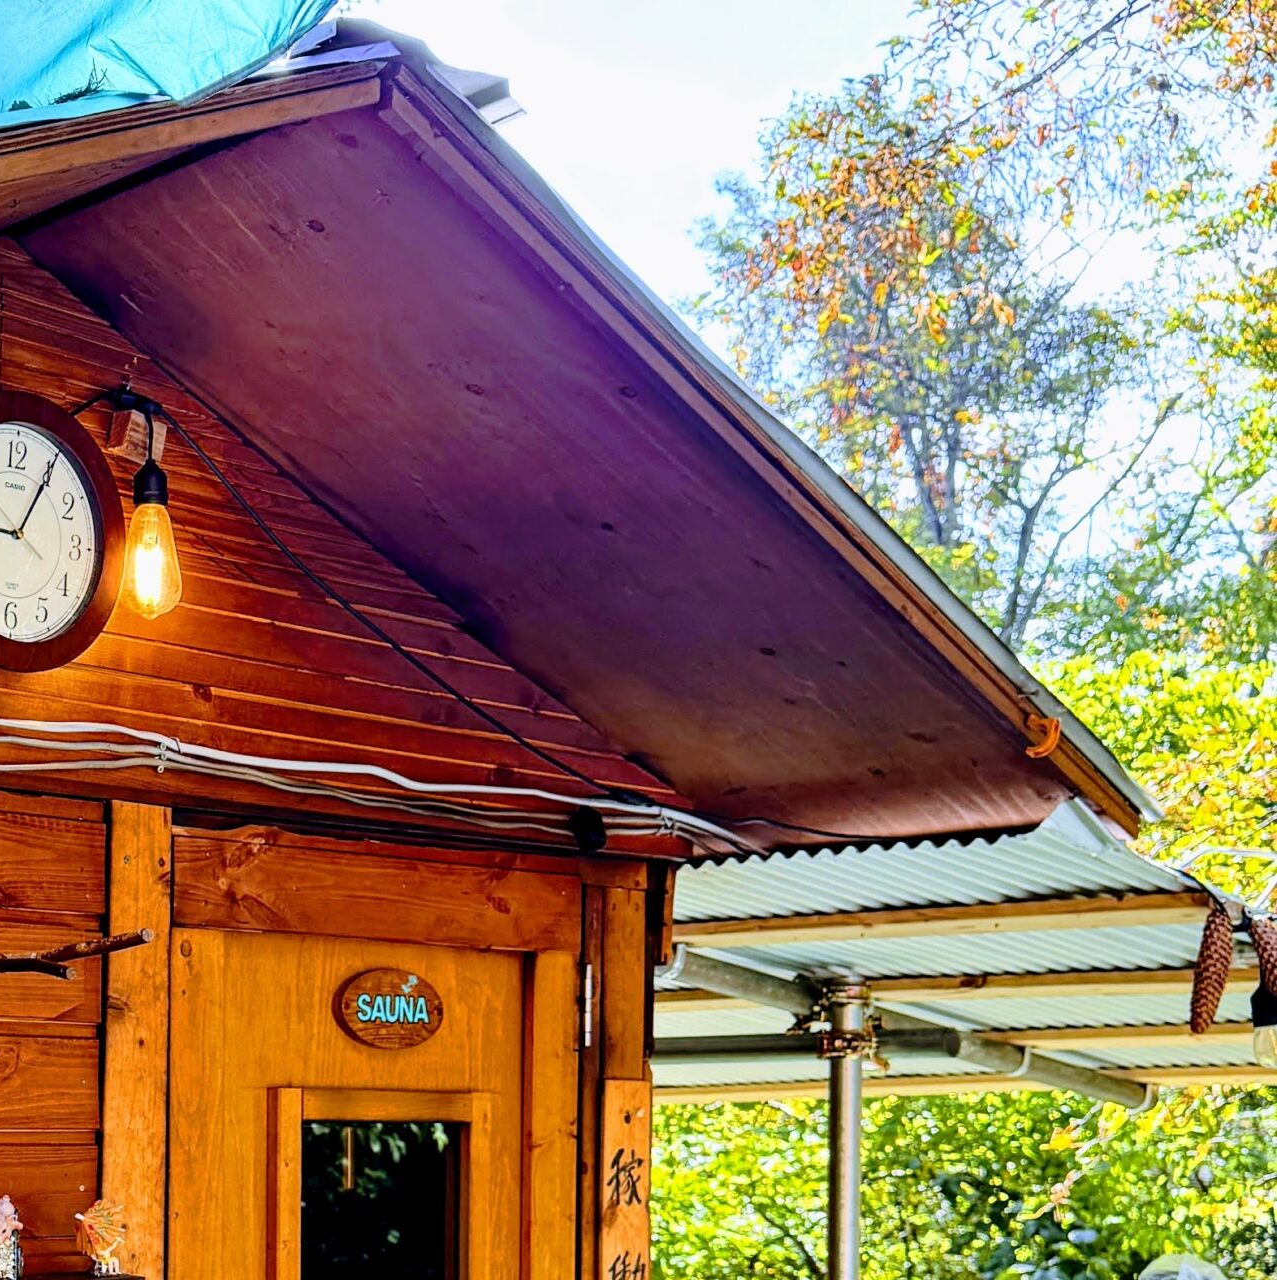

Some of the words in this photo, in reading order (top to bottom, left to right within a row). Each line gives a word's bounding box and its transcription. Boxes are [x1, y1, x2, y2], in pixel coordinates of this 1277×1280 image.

[7, 440, 28, 471] 12
[62, 492, 75, 521] 2
[68, 534, 82, 561] 3
[56, 572, 69, 597] 4
[4, 601, 18, 630] 6
[35, 597, 48, 624] 5
[356, 993, 430, 1024] SAUNA
